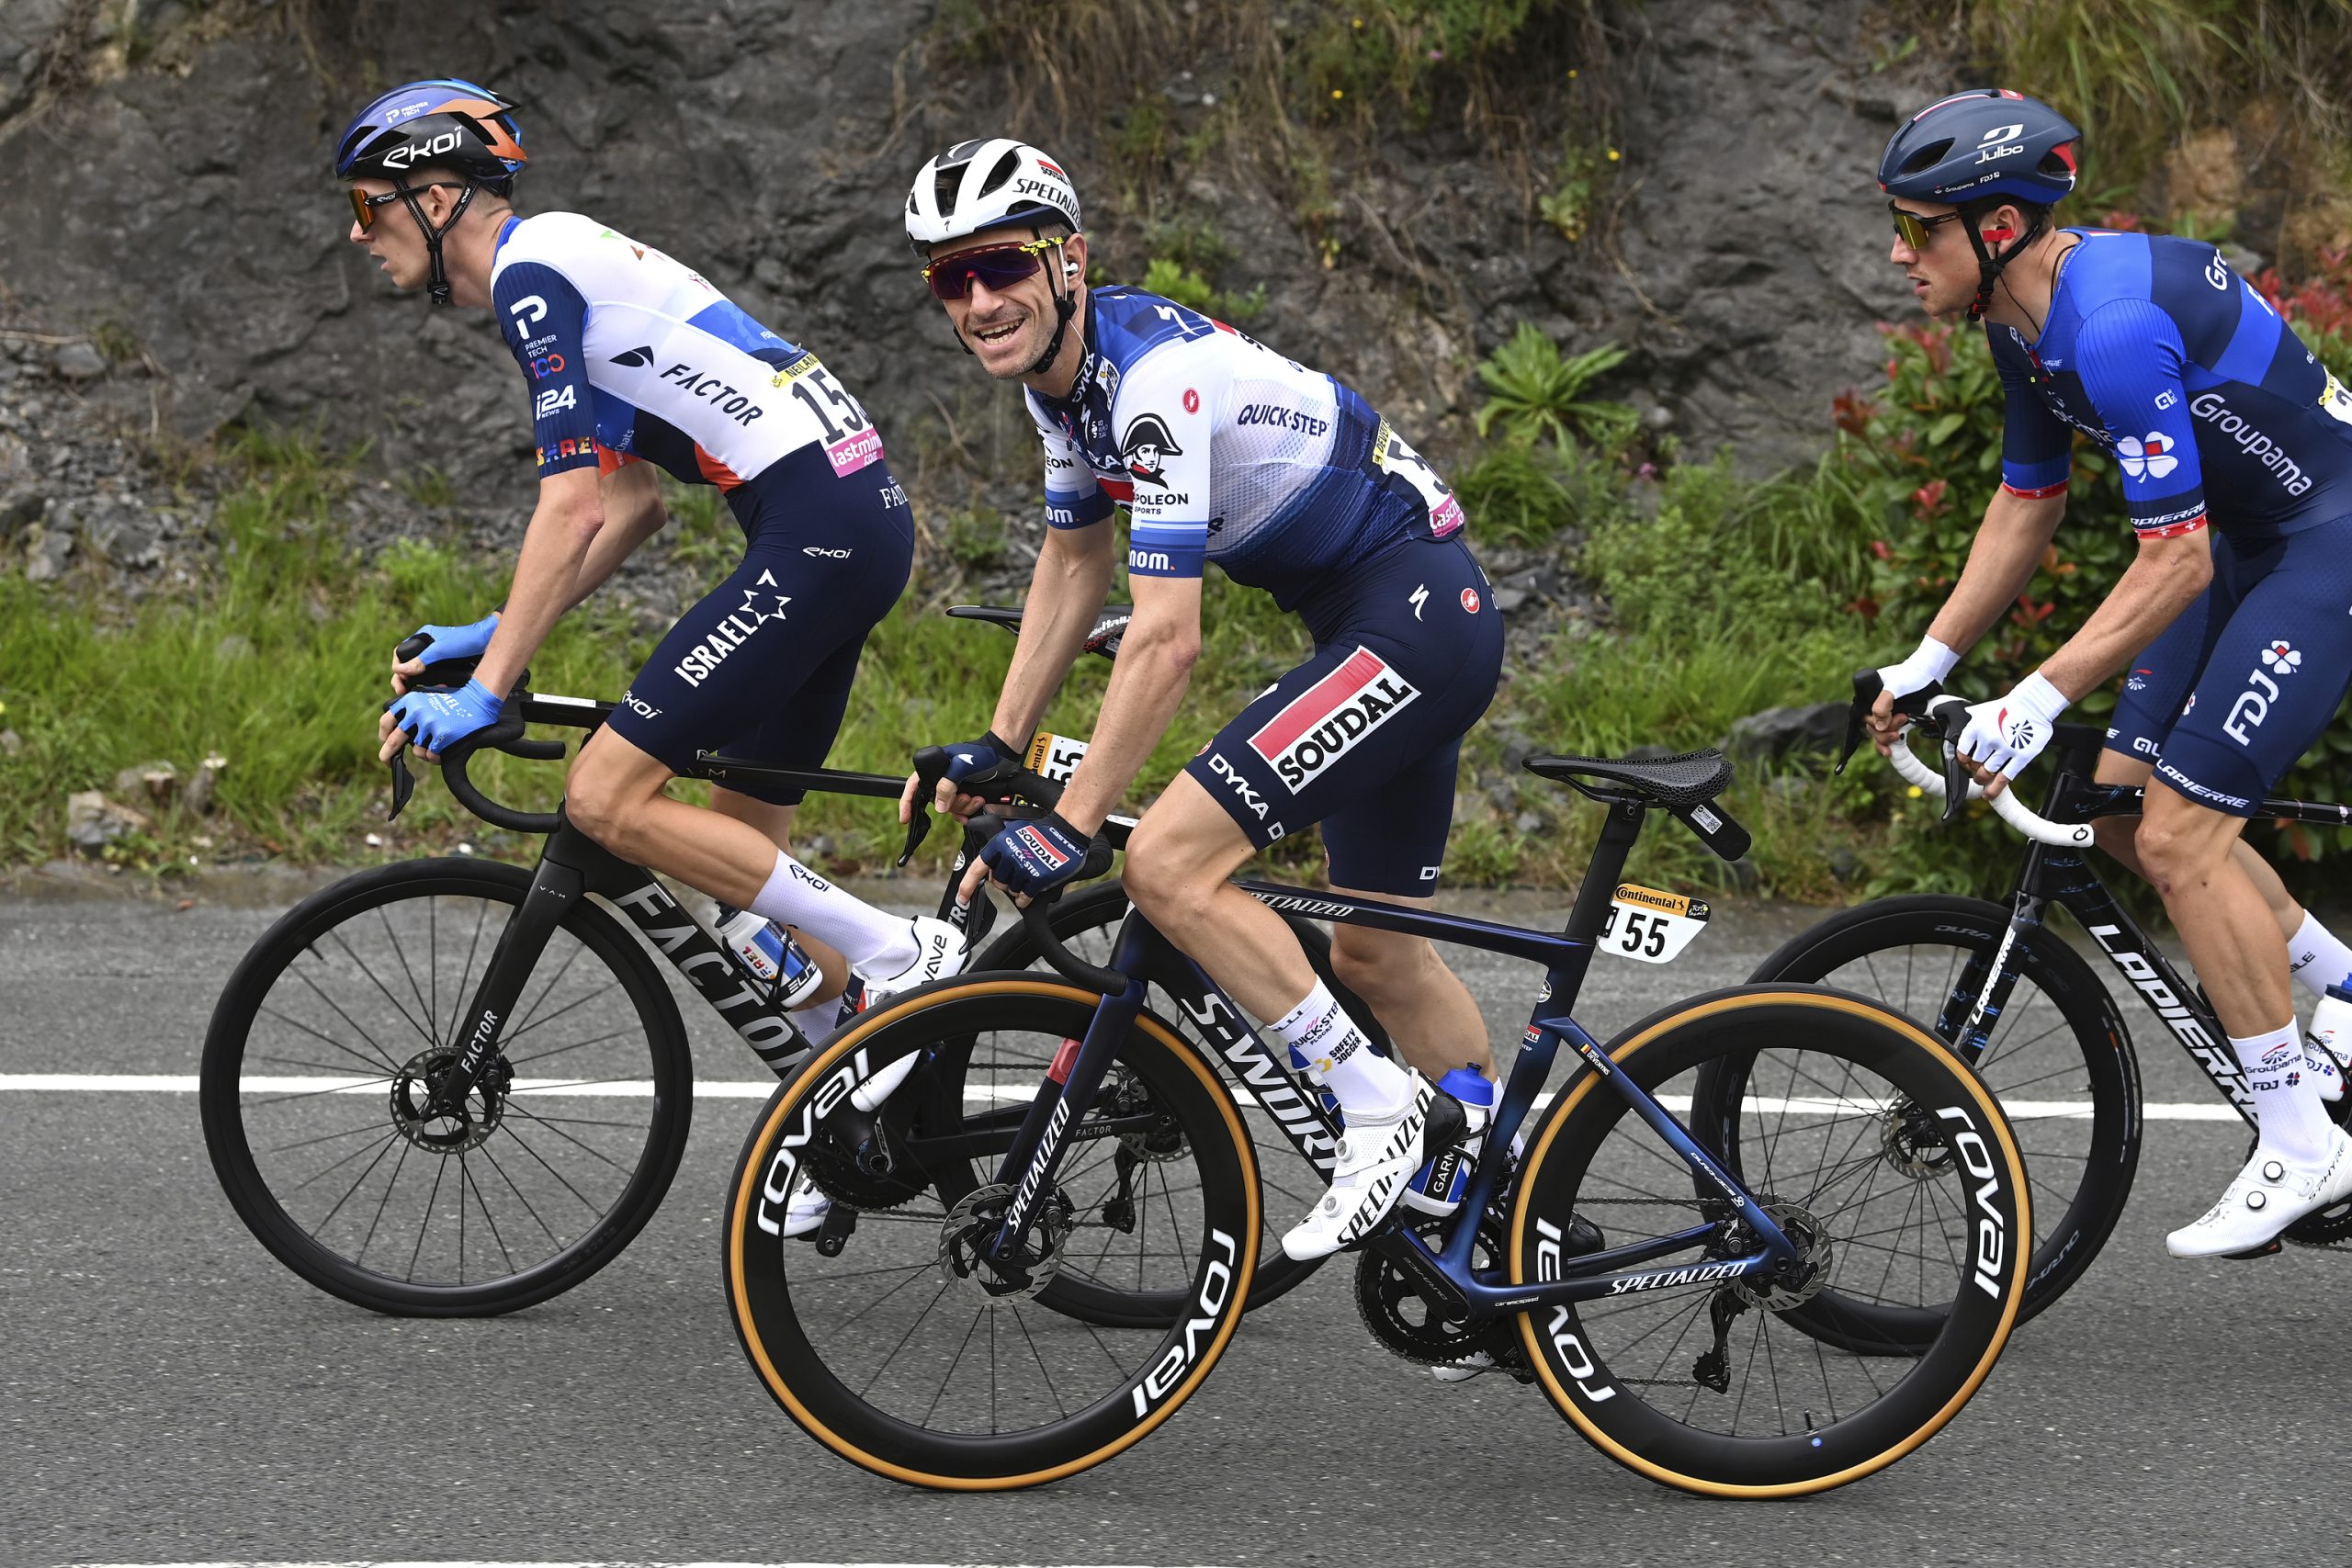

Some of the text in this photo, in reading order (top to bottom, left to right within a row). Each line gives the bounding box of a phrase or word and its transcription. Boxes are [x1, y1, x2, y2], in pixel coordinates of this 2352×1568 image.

[1975, 144, 2024, 165] Julbo
[1979, 174, 1994, 184] FDJ
[525, 333, 558, 351] PREMIER
[527, 345, 548, 359] TECH
[529, 353, 566, 379] 100
[659, 363, 763, 426] FACTOR
[541, 408, 560, 419] NEWS
[2190, 392, 2313, 497] Groupama
[673, 614, 759, 688] ISRAEL
[2222, 669, 2279, 747] FDJ
[1277, 677, 1413, 788] SOUDAL
[1207, 752, 1270, 820] DYKA
[2155, 759, 2250, 808] LAPIERRE
[1018, 829, 1058, 869] SOUDAL
[1615, 886, 1677, 909] Continental
[1622, 912, 1669, 957] 55
[1972, 925, 2017, 1026] LAPIERRE
[460, 1010, 499, 1074] FACTOR
[1309, 1025, 1333, 1045] FLOORS
[1329, 1027, 1356, 1058] SAFETY
[1334, 1036, 1363, 1065] JOGGER
[1587, 1052, 1611, 1076] DEVENYNS
[2245, 1054, 2302, 1075] Groupama
[2253, 1080, 2279, 1091] FDJ
[1075, 1124, 1112, 1137] FACTOR
[1007, 1096, 1070, 1235] SPECIALIZED
[1605, 1262, 1748, 1296] SPECIALIZED
